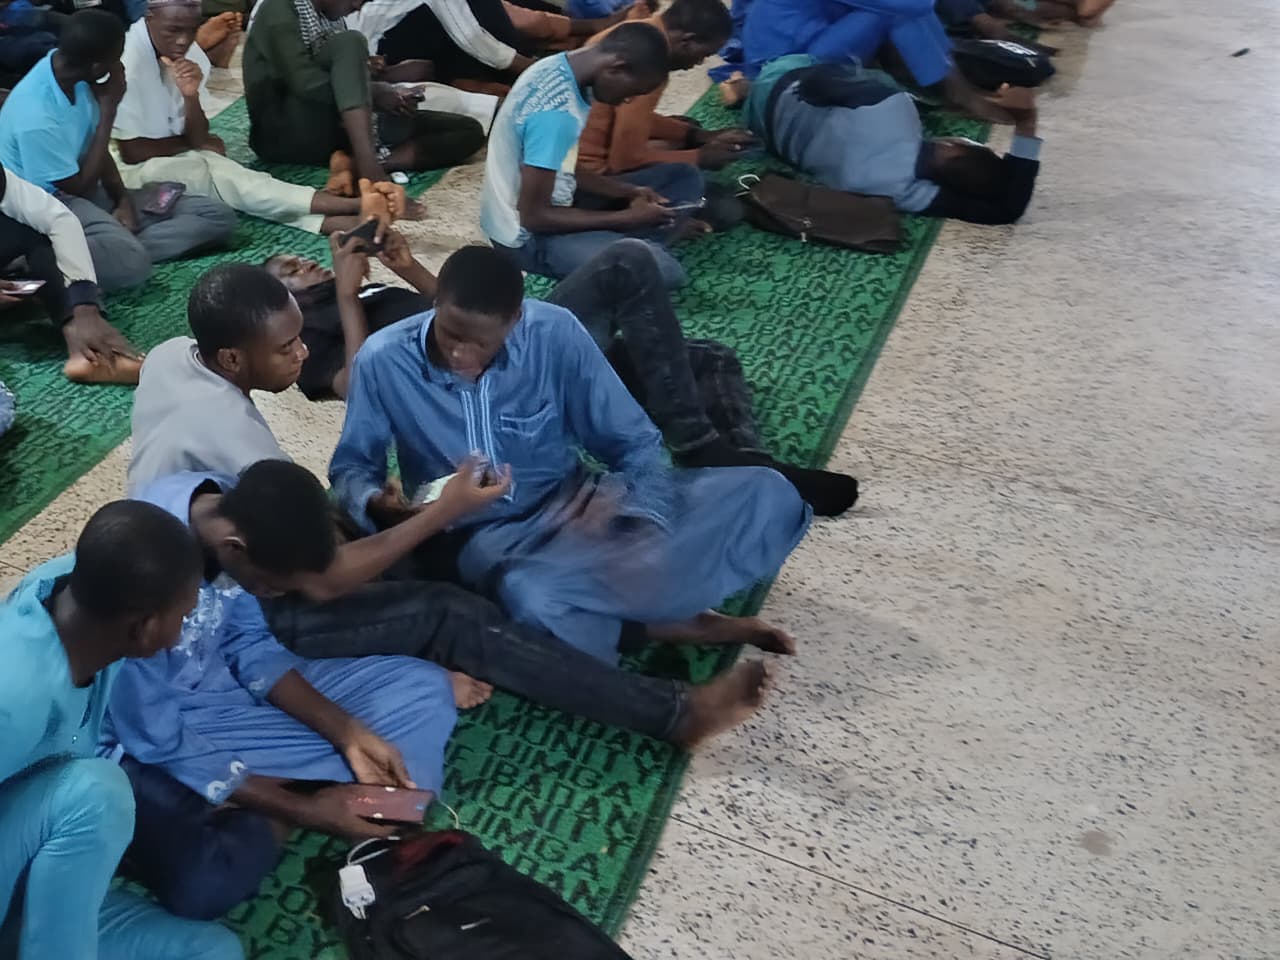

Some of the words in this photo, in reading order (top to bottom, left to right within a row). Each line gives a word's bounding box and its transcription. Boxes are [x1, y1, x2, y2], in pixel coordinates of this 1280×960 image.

[480, 753, 642, 838] IBADAN
[487, 734, 637, 807] UIMGA
[450, 799, 606, 882] UIMGA
